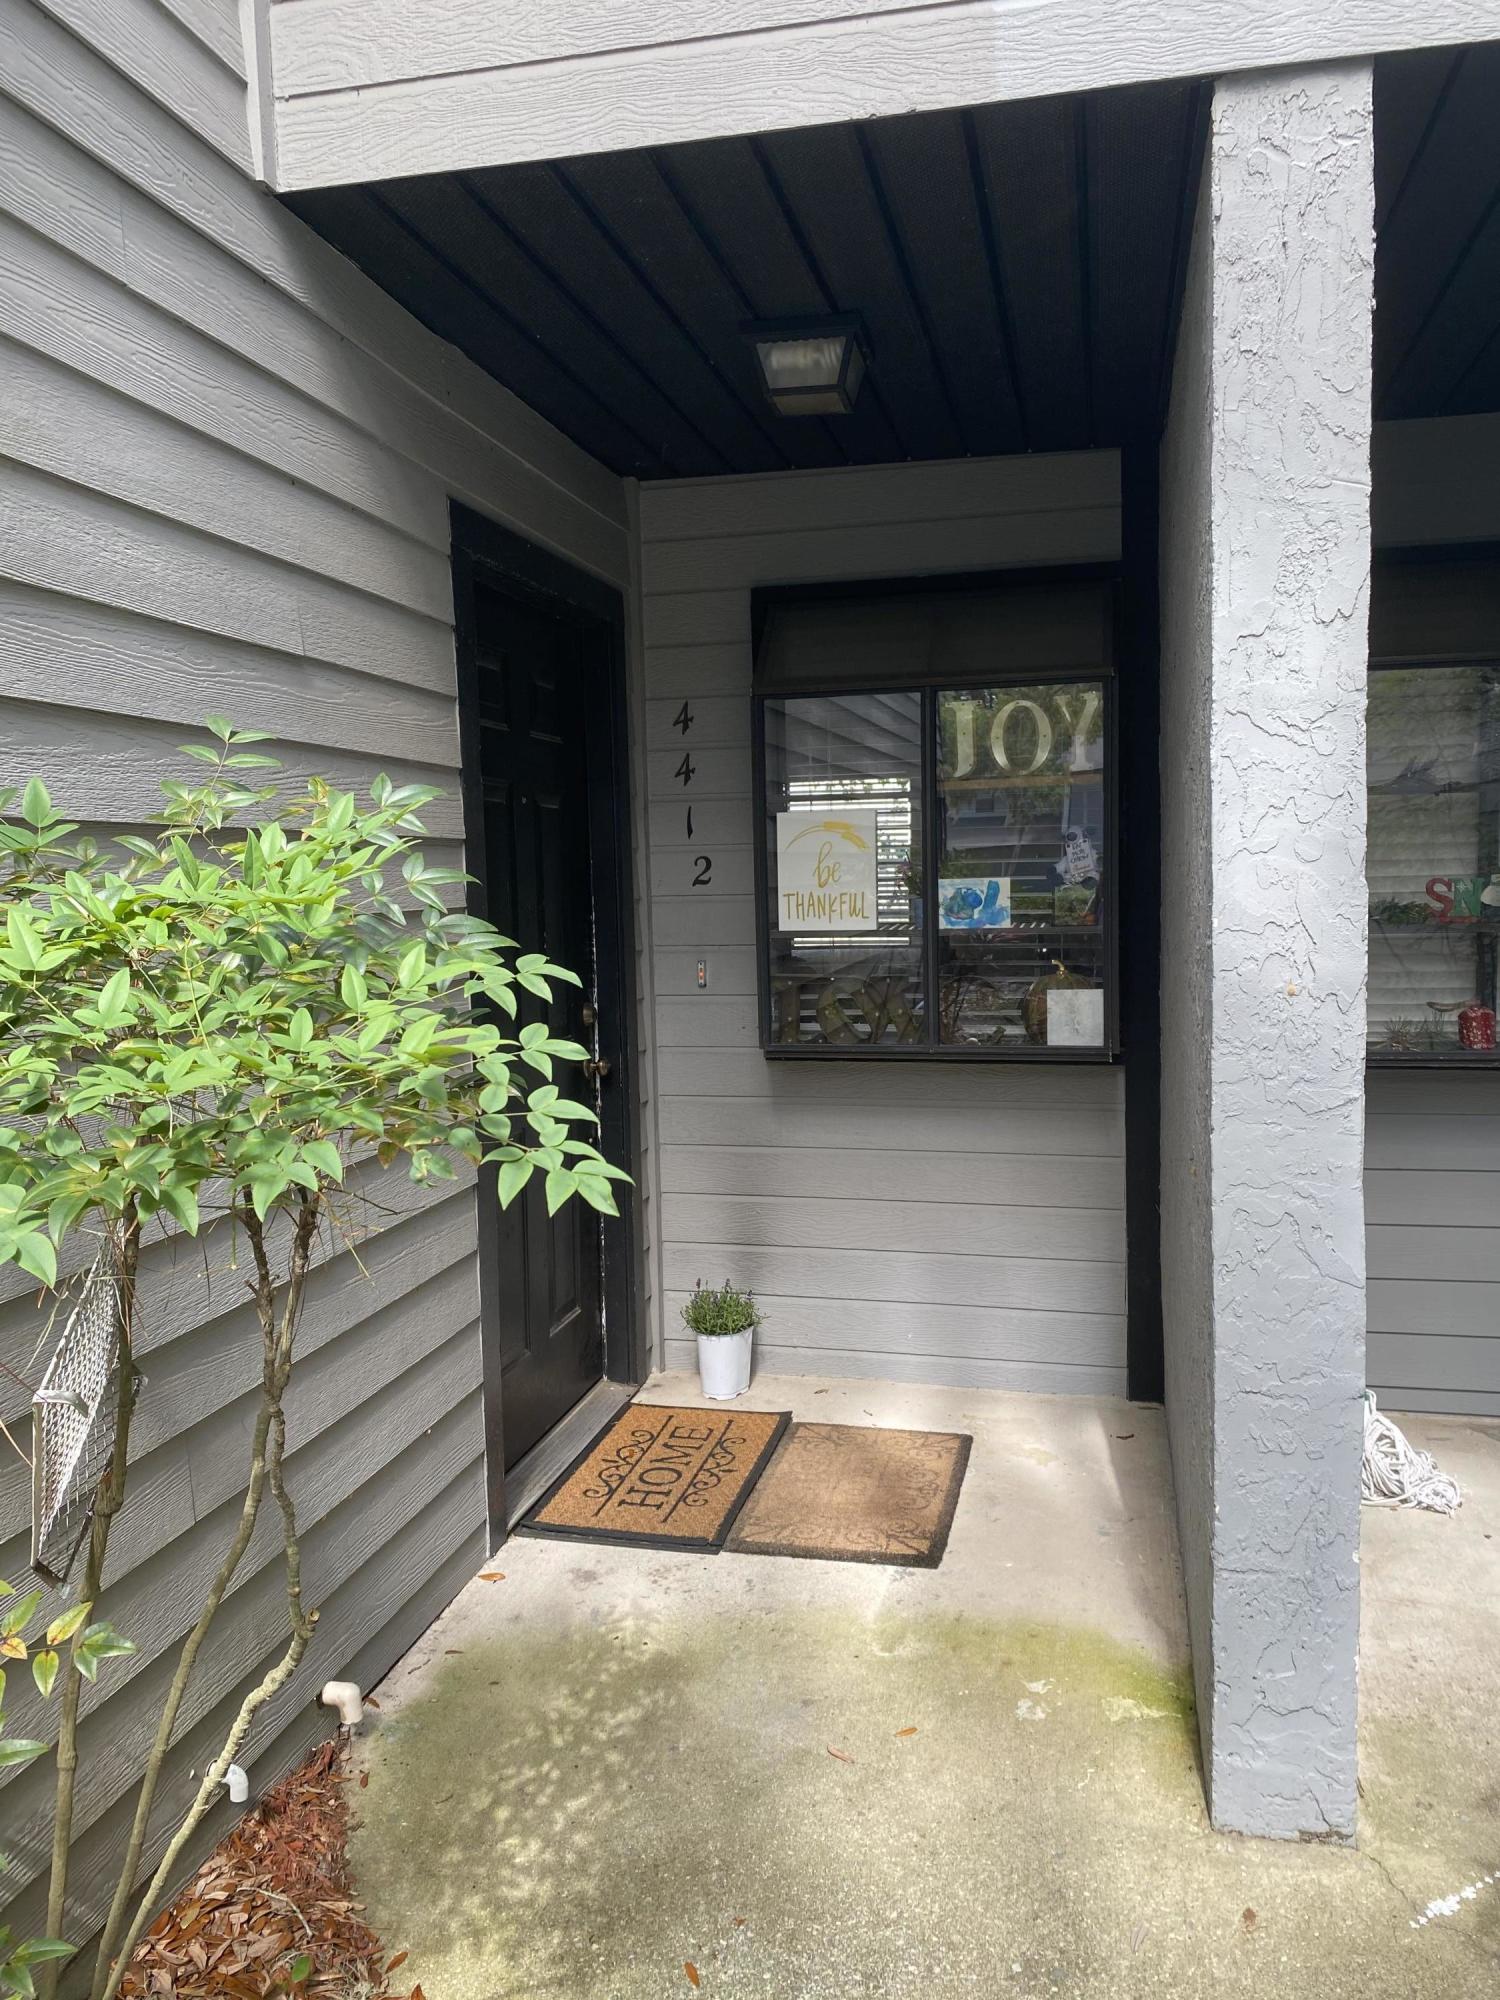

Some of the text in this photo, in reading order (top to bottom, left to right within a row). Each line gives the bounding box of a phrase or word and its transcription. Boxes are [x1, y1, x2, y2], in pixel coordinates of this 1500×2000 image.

[945, 690, 1099, 778] JOY
[812, 841, 842, 888] be
[783, 891, 870, 923] THANKFUL
[617, 1426, 714, 1510] HOME
